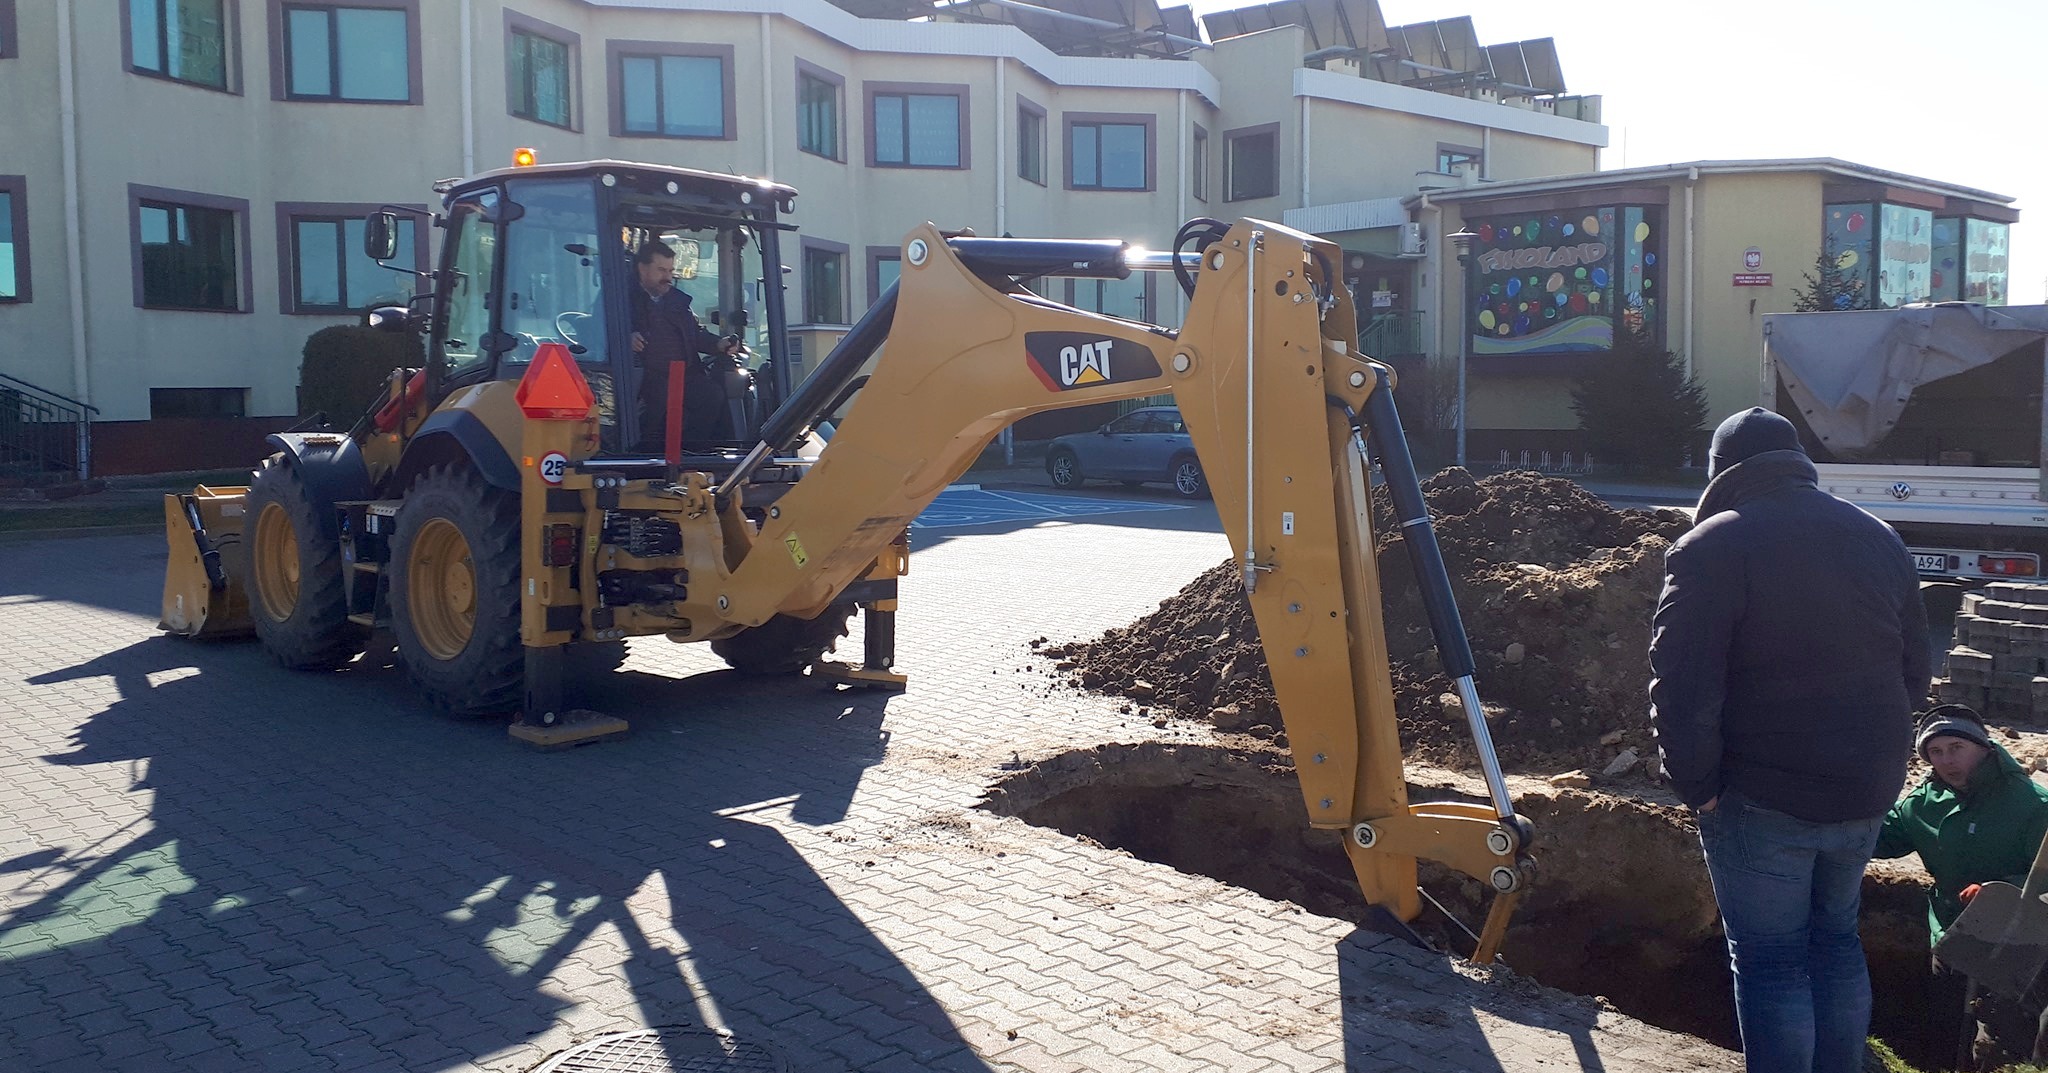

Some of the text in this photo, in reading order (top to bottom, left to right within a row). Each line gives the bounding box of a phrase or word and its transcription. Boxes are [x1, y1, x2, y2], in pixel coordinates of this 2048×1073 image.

[1060, 340, 1113, 386] CAT
[544, 460, 564, 476] 25
[1912, 555, 1943, 569] A94
